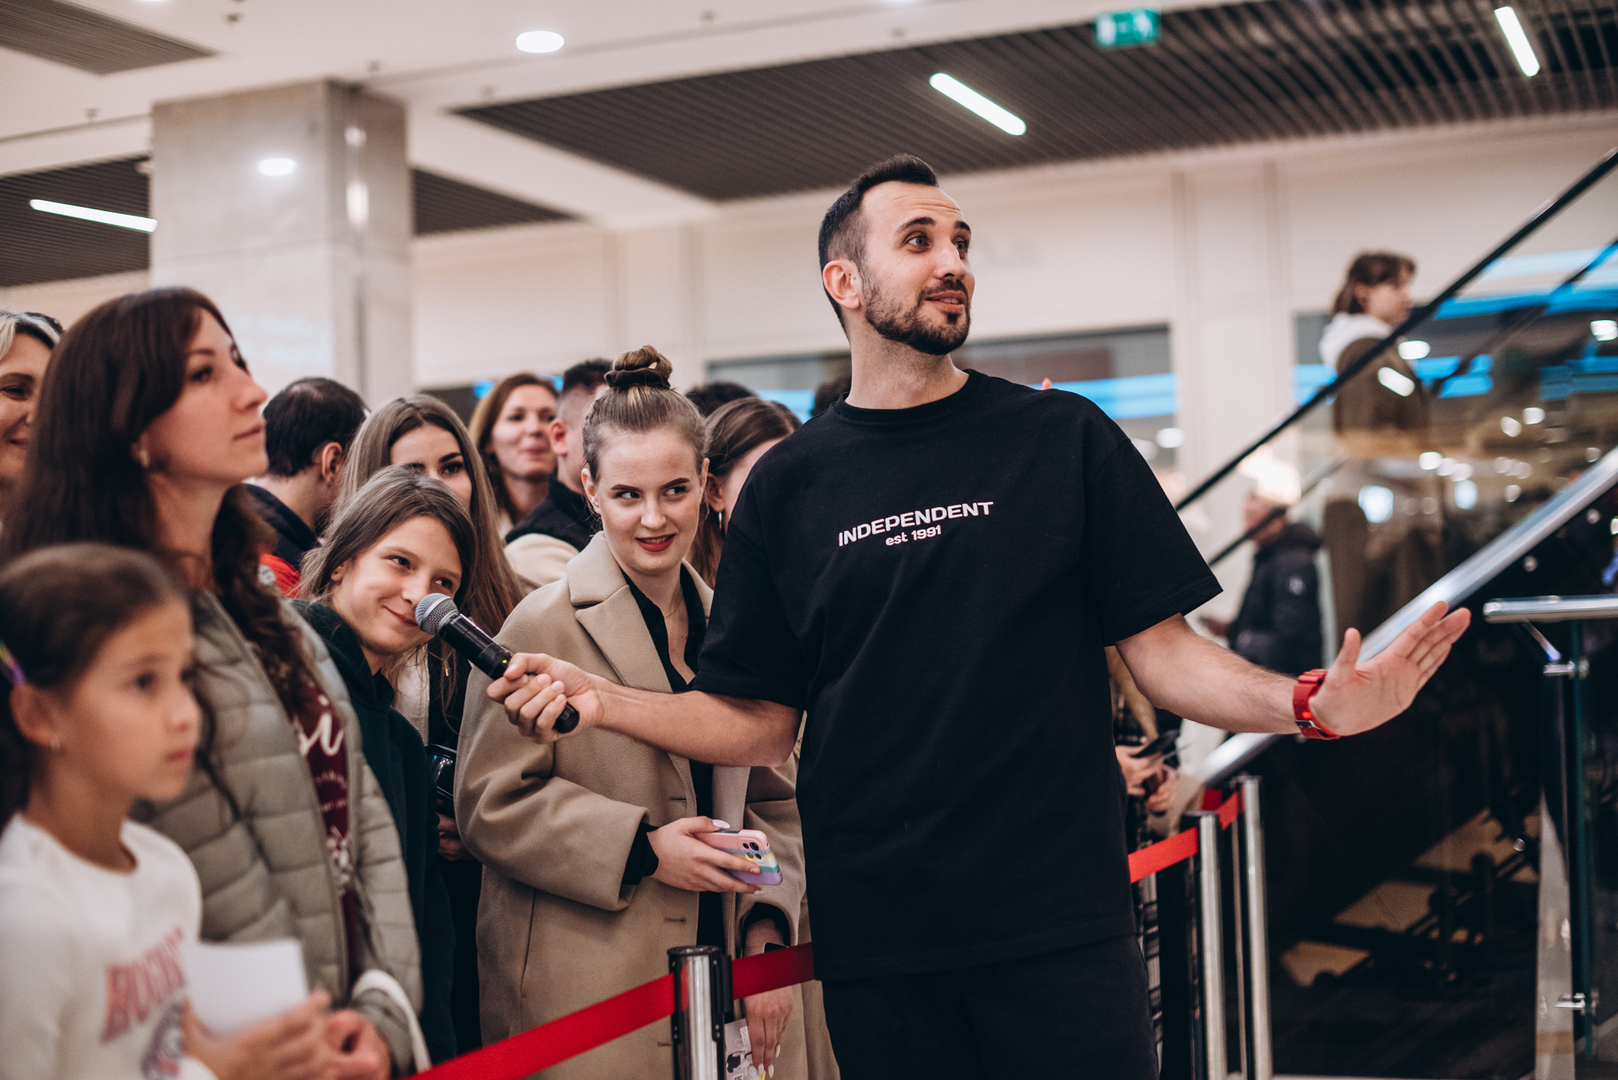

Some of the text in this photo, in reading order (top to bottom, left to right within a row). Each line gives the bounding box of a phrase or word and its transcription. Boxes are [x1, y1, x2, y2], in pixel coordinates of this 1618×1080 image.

[838, 501, 994, 547] INDEPENDENT
[885, 525, 942, 546] est 1991
